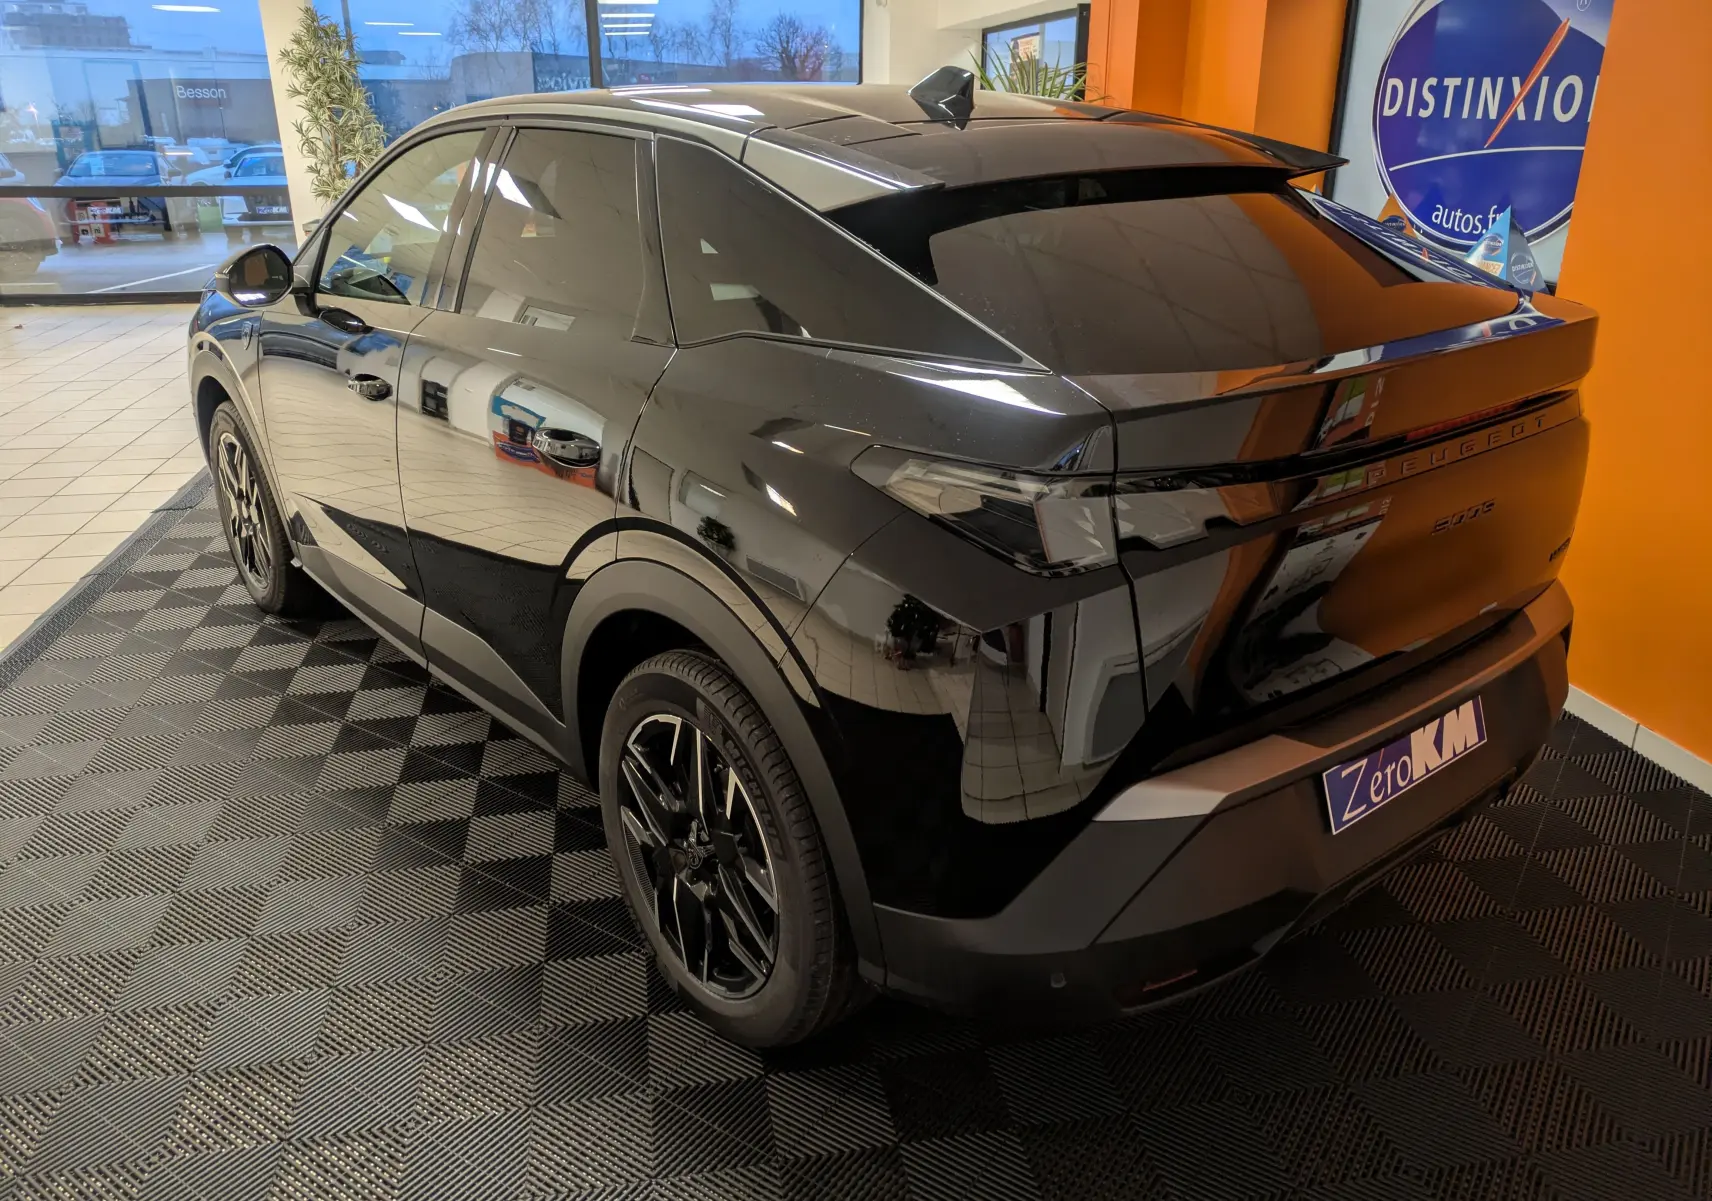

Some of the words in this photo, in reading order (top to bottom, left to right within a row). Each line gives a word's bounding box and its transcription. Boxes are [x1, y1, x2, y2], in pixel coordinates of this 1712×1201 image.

[176, 85, 227, 99] Besson
[1365, 413, 1548, 487] PEUGEOT
[724, 738, 787, 862] MICHELIN
